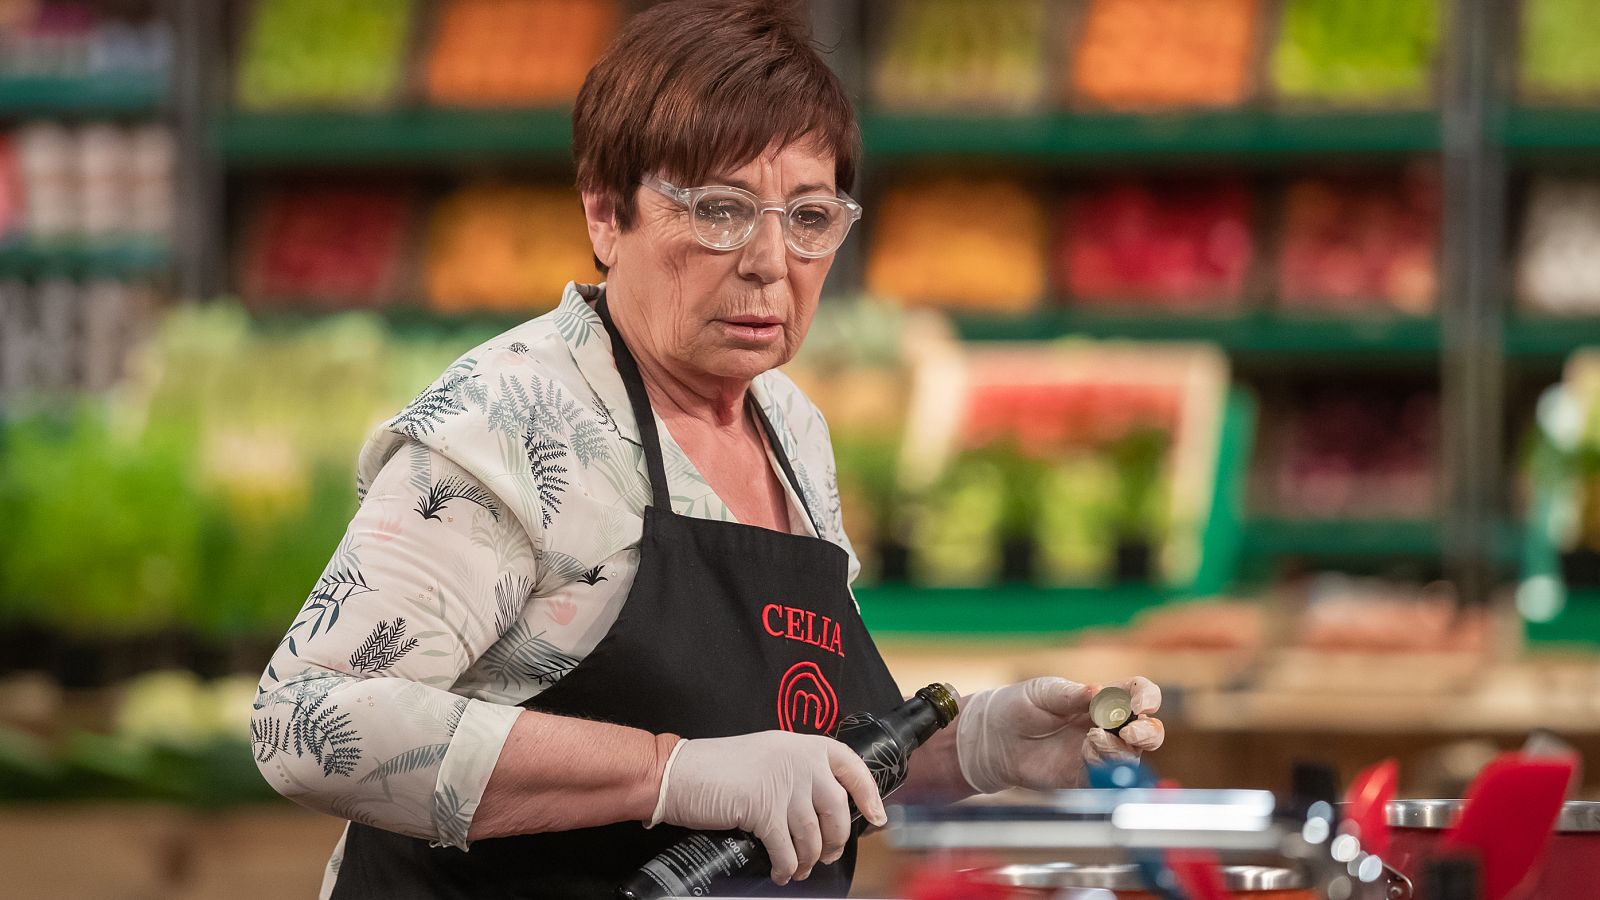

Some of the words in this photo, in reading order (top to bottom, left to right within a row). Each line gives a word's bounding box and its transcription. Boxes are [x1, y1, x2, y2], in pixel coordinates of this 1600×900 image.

[762, 603, 845, 657] CELIA
[724, 837, 741, 854] 500
[737, 852, 749, 866] ml
